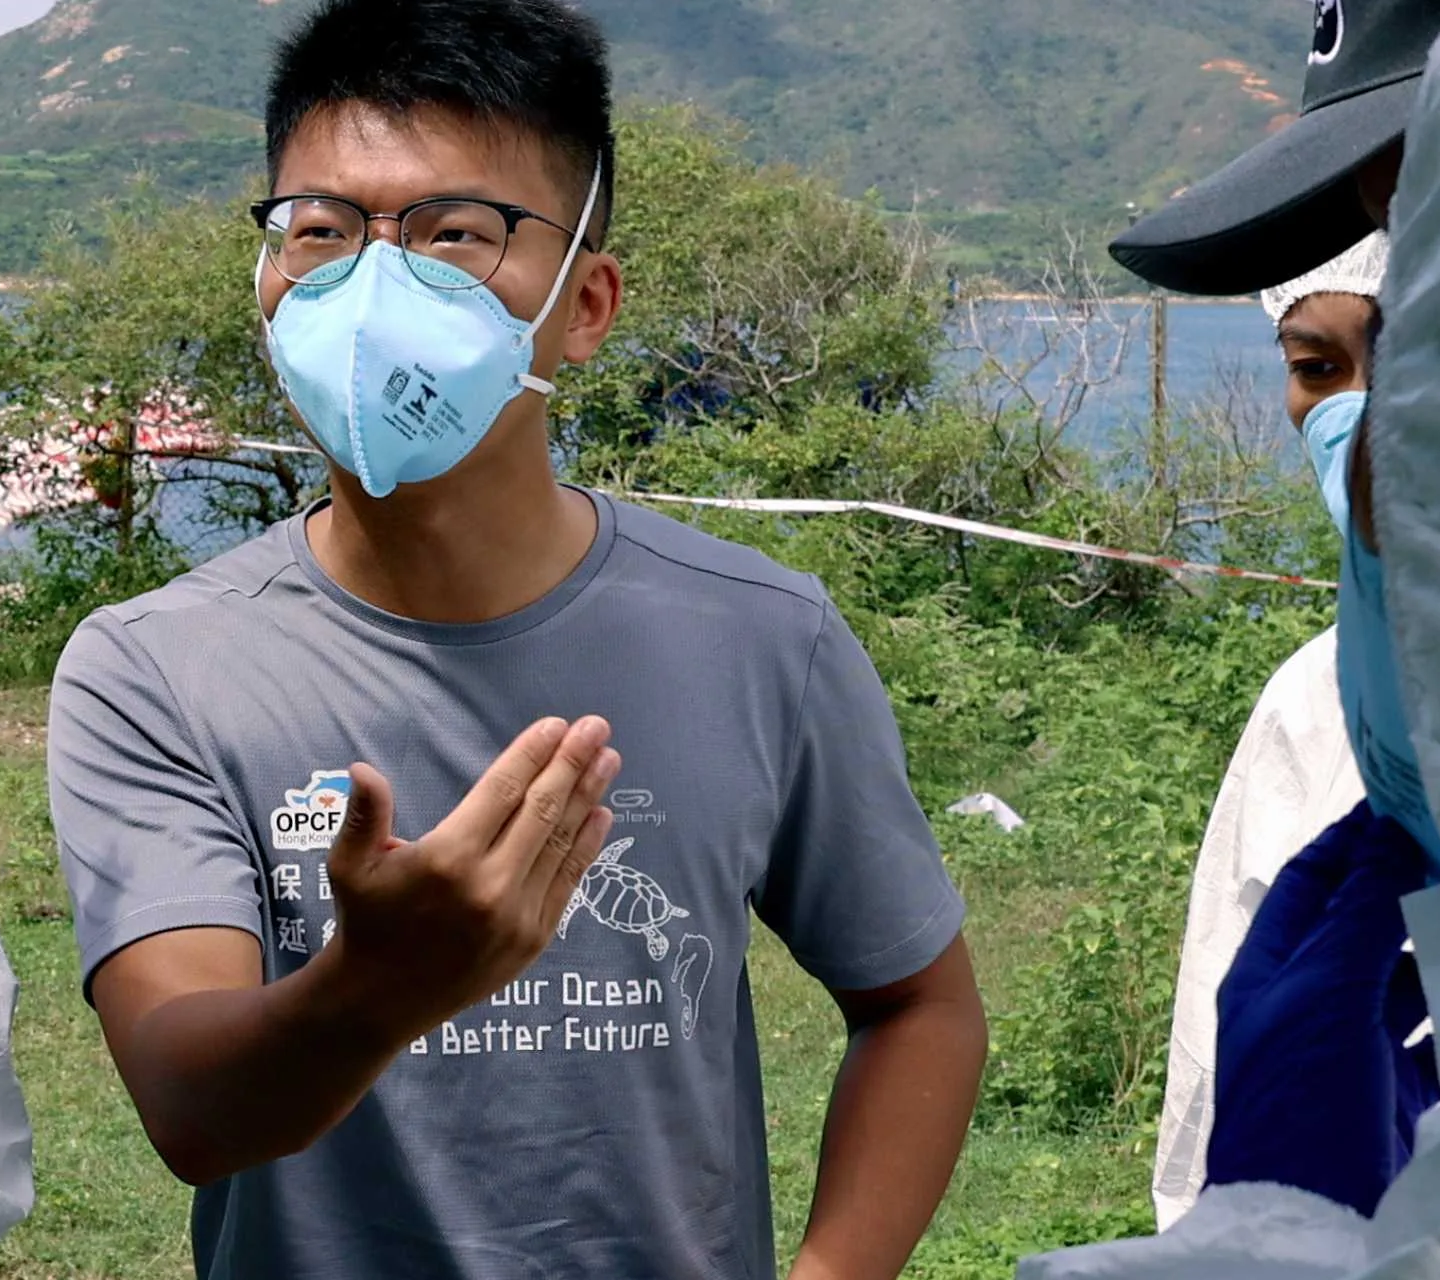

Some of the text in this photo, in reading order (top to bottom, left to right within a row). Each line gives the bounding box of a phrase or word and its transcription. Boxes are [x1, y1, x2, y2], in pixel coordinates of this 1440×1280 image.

[276, 811, 341, 832] OPCF
[612, 809, 667, 827] alenji
[277, 833, 307, 845] Hong
[562, 972, 663, 1007] Ocean
[441, 1018, 552, 1055] Better
[565, 1016, 670, 1052] Future
